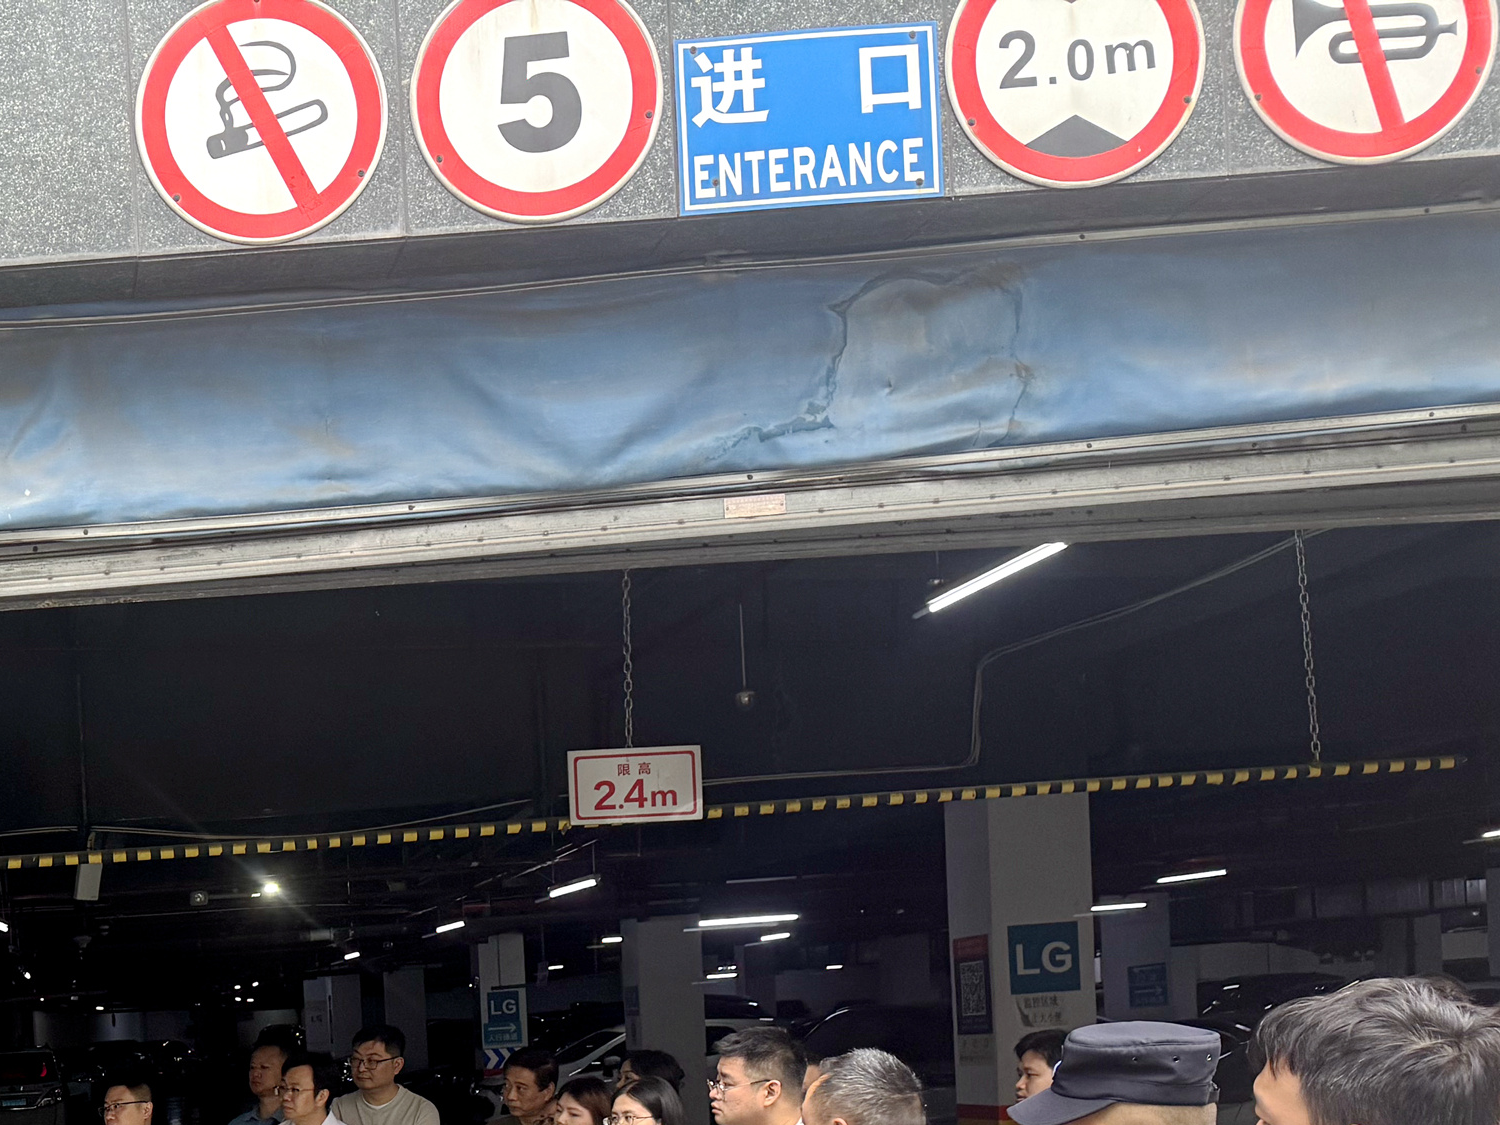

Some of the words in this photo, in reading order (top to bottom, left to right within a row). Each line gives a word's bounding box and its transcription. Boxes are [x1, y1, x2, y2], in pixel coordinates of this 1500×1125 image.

[998, 29, 1156, 90] 2.0m
[498, 31, 582, 153] 5
[690, 44, 923, 129] 进口
[693, 137, 925, 199] ENTERANCE
[617, 762, 651, 776] 限高
[593, 778, 678, 811] 2.4m
[1015, 941, 1073, 976] LG
[490, 998, 517, 1016] LG
